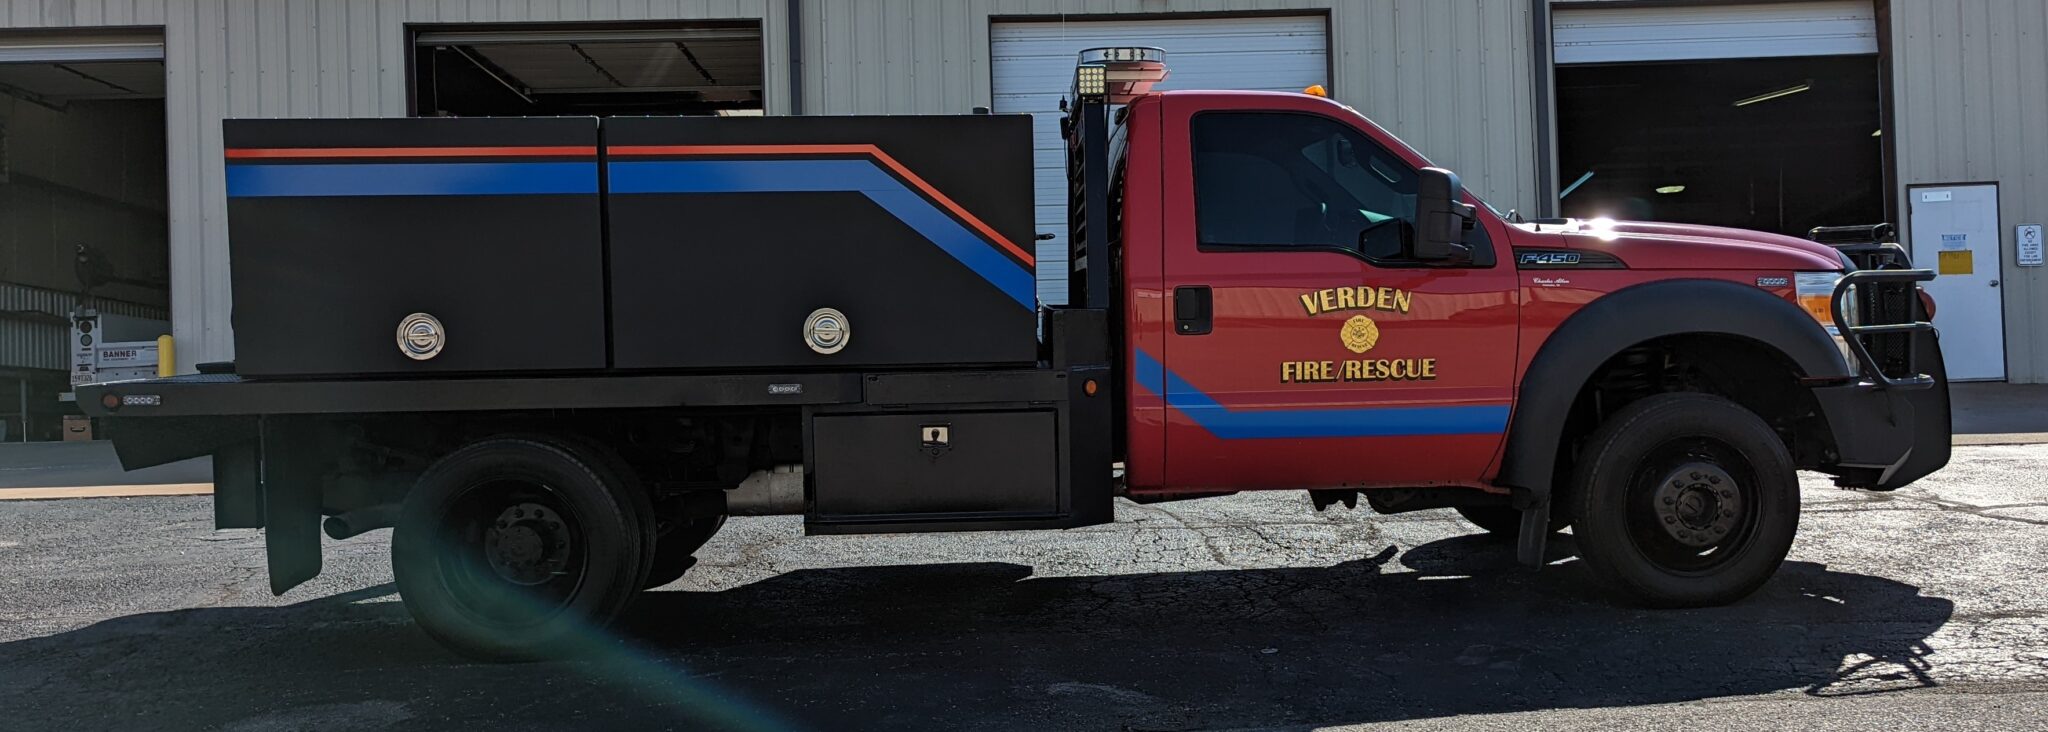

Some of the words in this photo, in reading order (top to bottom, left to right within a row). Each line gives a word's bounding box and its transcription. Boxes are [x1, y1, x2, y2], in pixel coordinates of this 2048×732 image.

[1300, 286, 1413, 316] VERDEN
[103, 350, 137, 358] BANNER
[1280, 358, 1437, 383] FIRE/RESCUE
